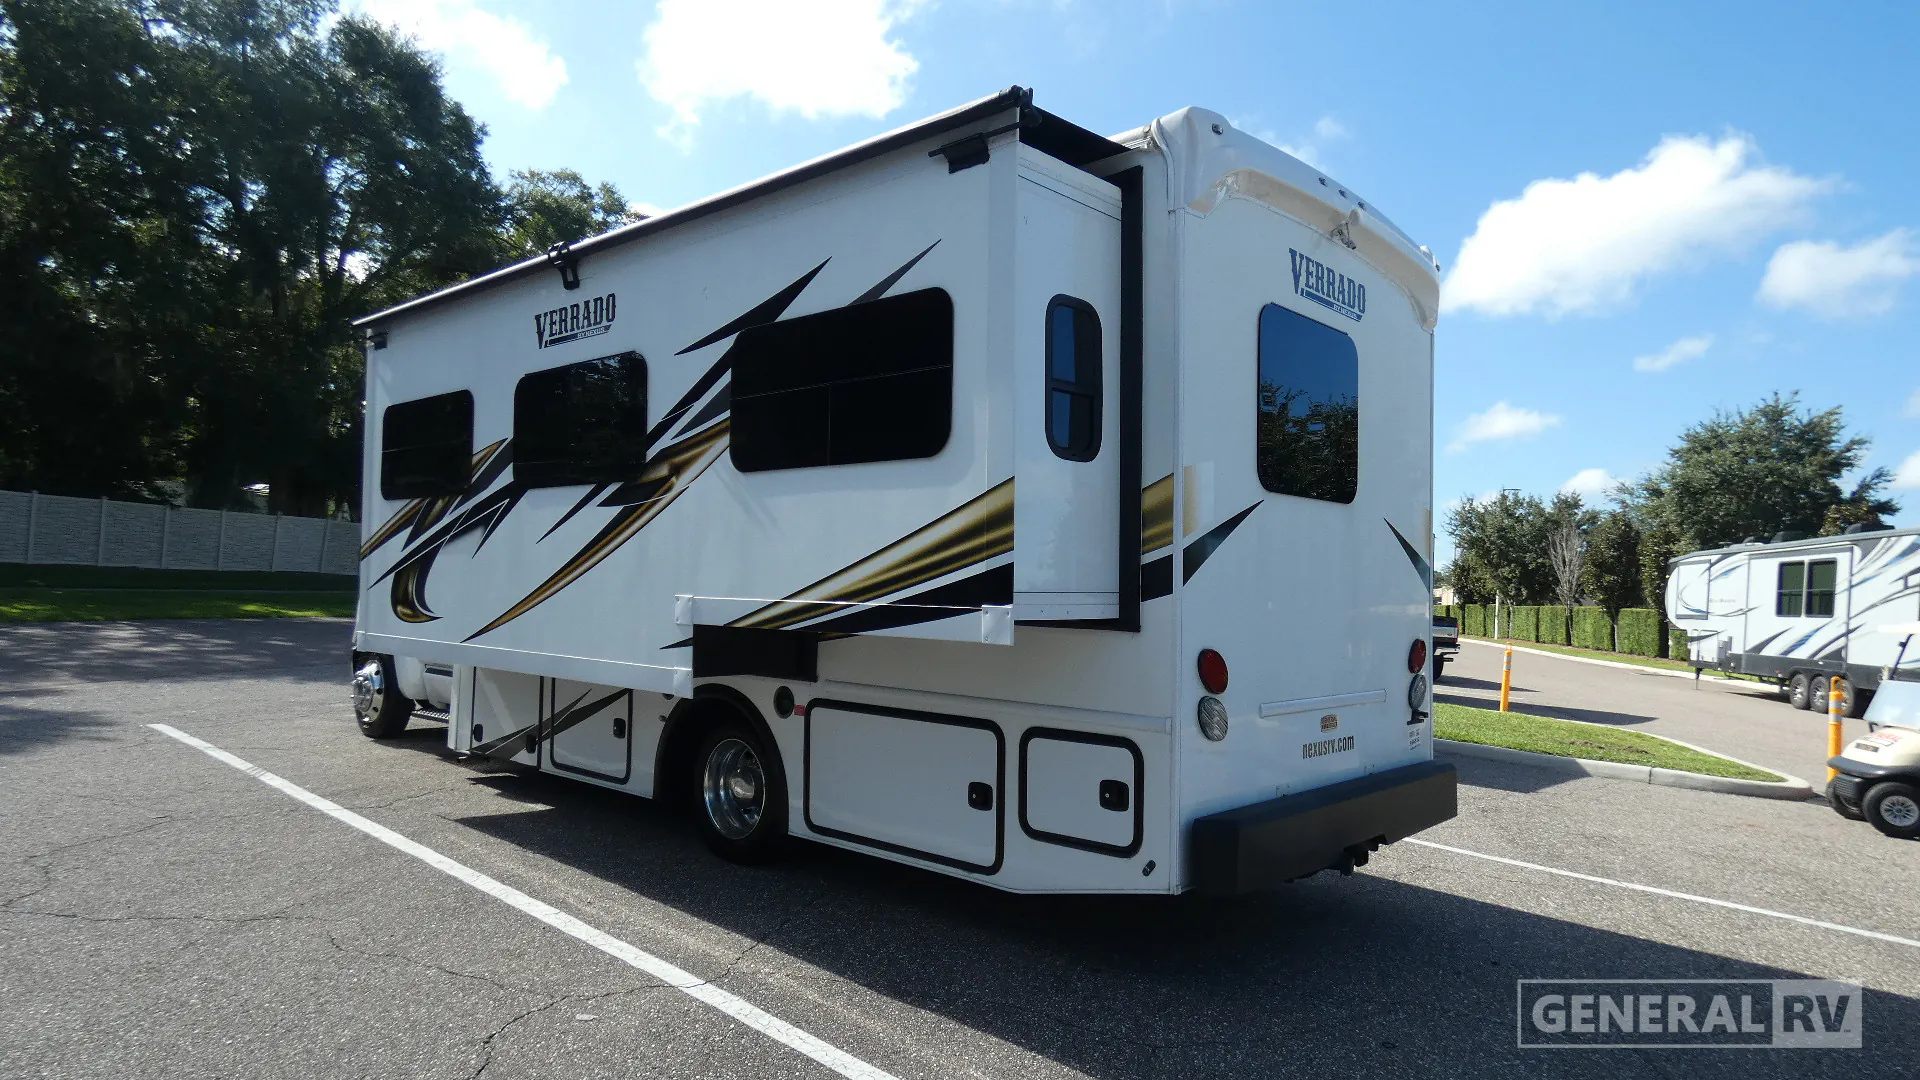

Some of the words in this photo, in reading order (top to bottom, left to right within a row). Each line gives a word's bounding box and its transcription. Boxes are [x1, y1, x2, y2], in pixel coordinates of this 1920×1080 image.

[1289, 247, 1366, 314] VERRADO
[535, 293, 616, 349] VERRADO
[1302, 735, 1355, 759] nexusrv.com
